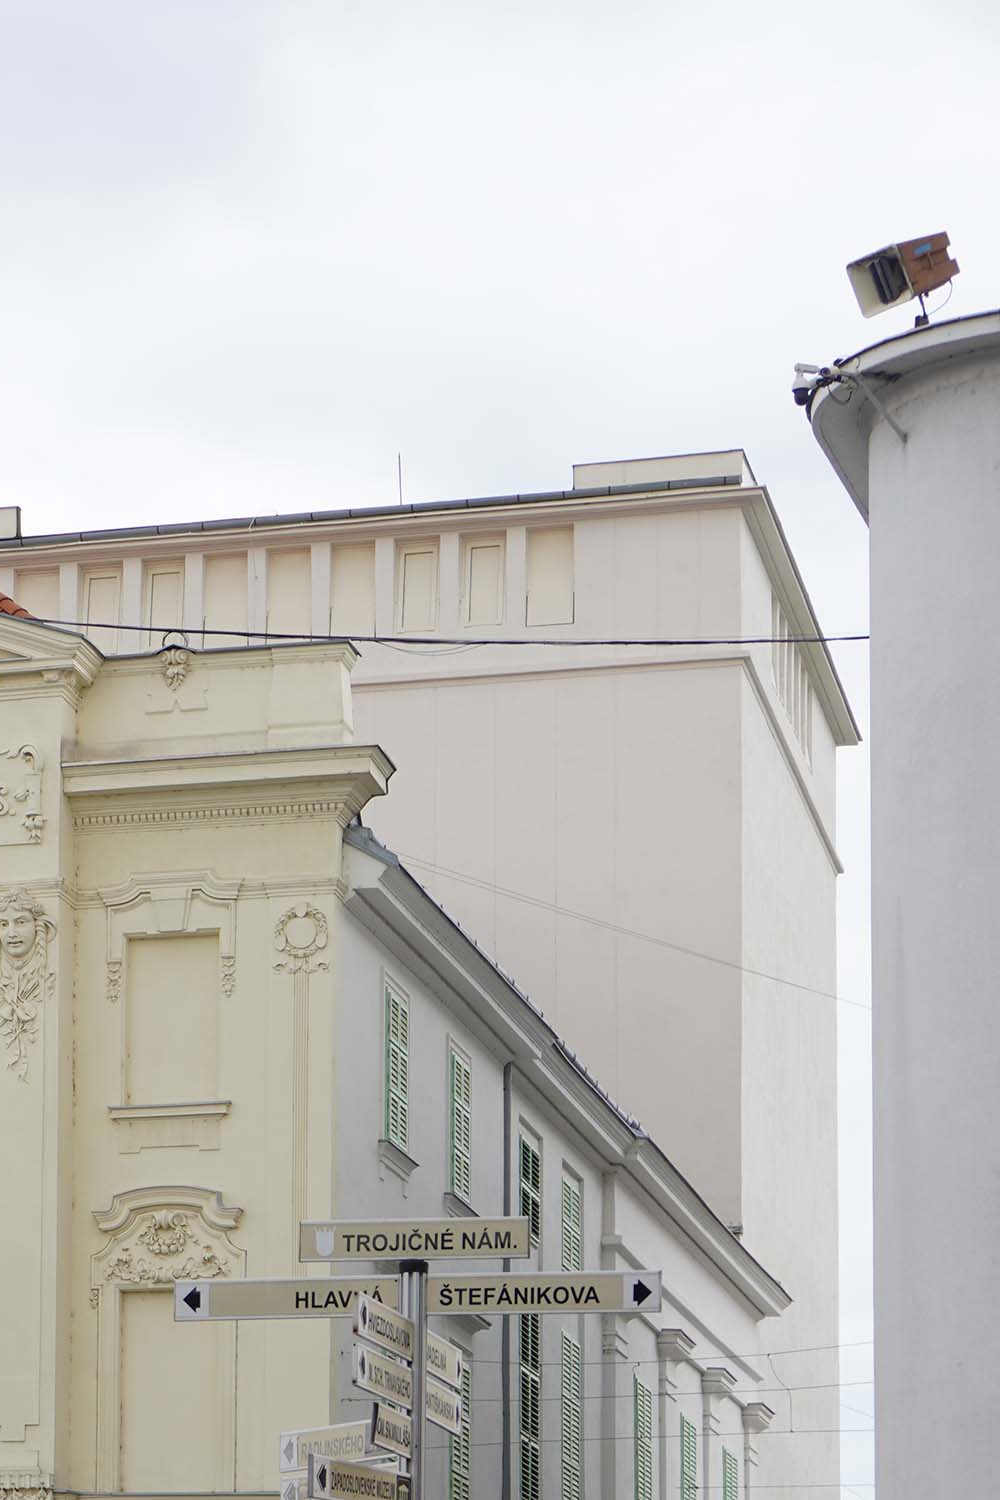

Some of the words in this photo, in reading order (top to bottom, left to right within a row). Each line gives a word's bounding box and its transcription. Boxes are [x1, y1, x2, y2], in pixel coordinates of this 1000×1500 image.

[342, 1228, 454, 1252] TROJIČNÉ
[462, 1227, 518, 1250] NÁM.
[295, 1286, 383, 1309] HLAVÁ
[439, 1282, 600, 1306] ŠTEFÁNIKOVA
